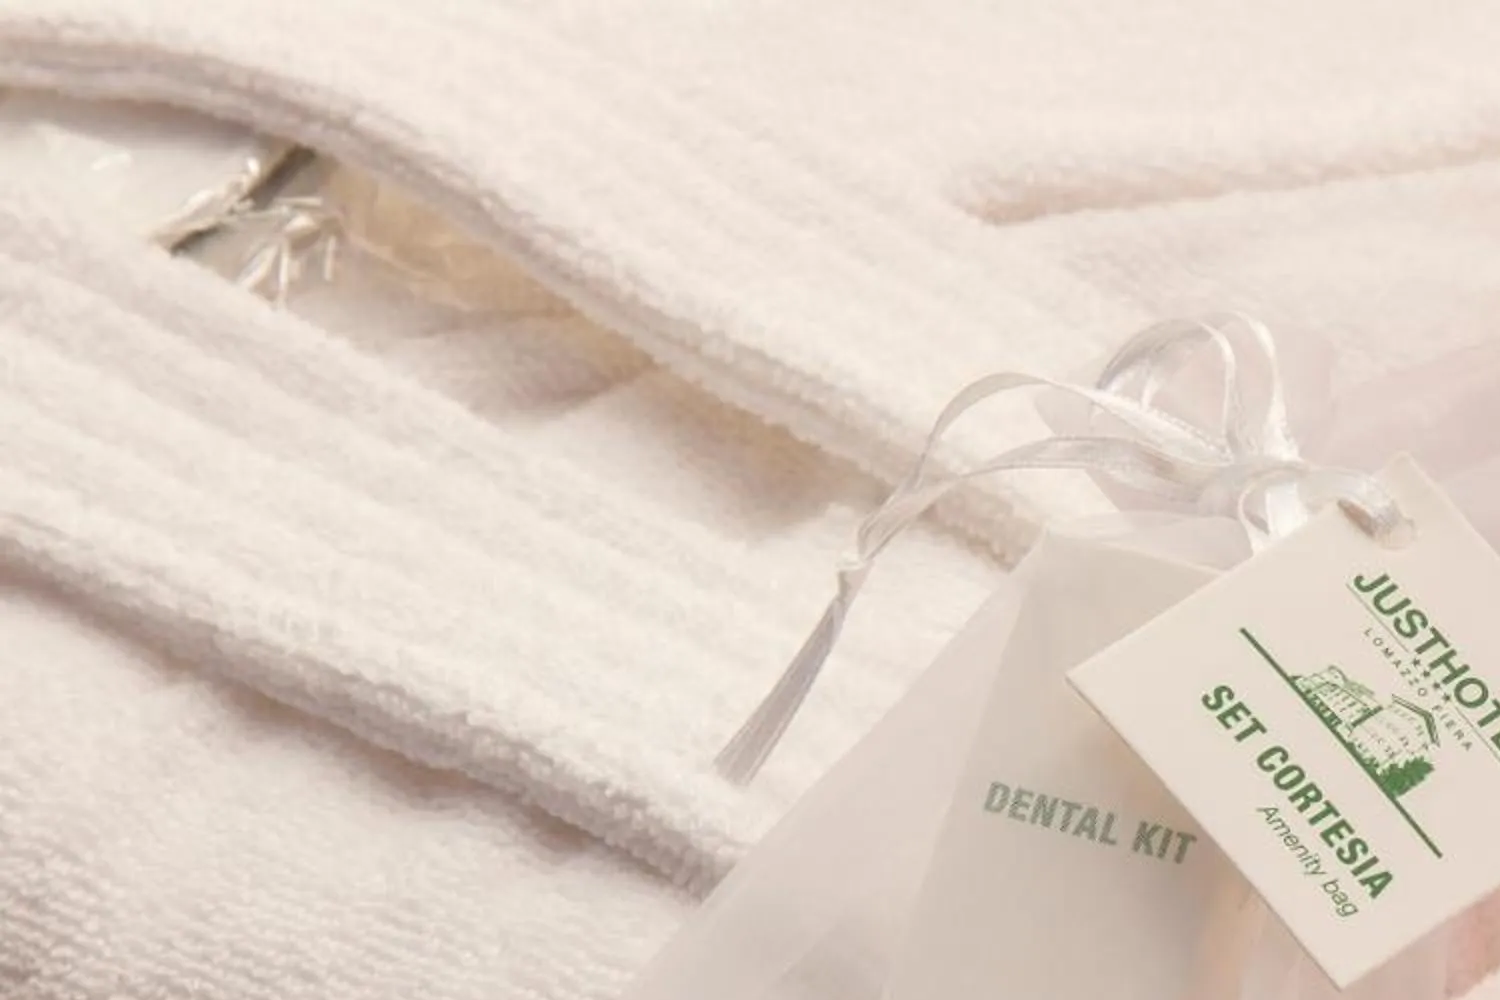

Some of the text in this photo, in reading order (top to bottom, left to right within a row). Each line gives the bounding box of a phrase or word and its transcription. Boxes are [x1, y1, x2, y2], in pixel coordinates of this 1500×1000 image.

[1363, 628, 1428, 697] LOMAZZO
[984, 781, 1198, 865] DENTAL KIT
[1201, 685, 1393, 899] SET CORTESIA
[1256, 806, 1359, 918] Amenity bag
